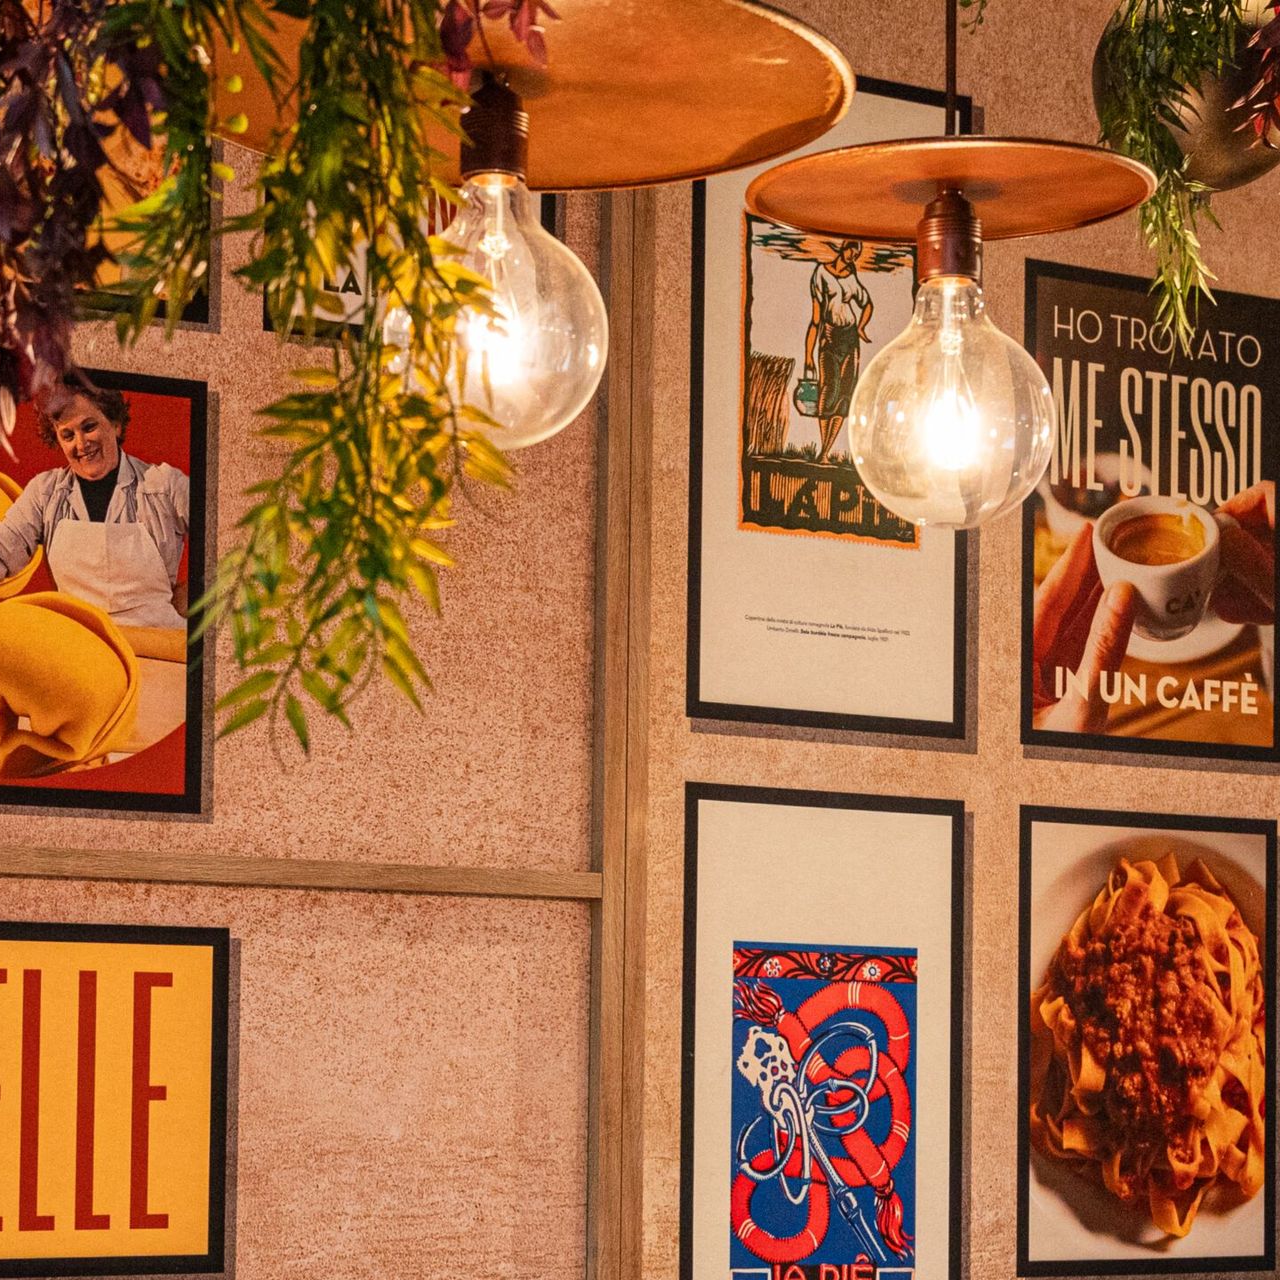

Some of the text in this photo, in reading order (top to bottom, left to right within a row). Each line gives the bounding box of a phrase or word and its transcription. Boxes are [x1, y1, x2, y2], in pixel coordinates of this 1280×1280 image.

[1053, 305, 1102, 343] HO
[1051, 357, 1262, 506] ME STESSO
[1054, 666, 1259, 714] IN UN CAFFÈ
